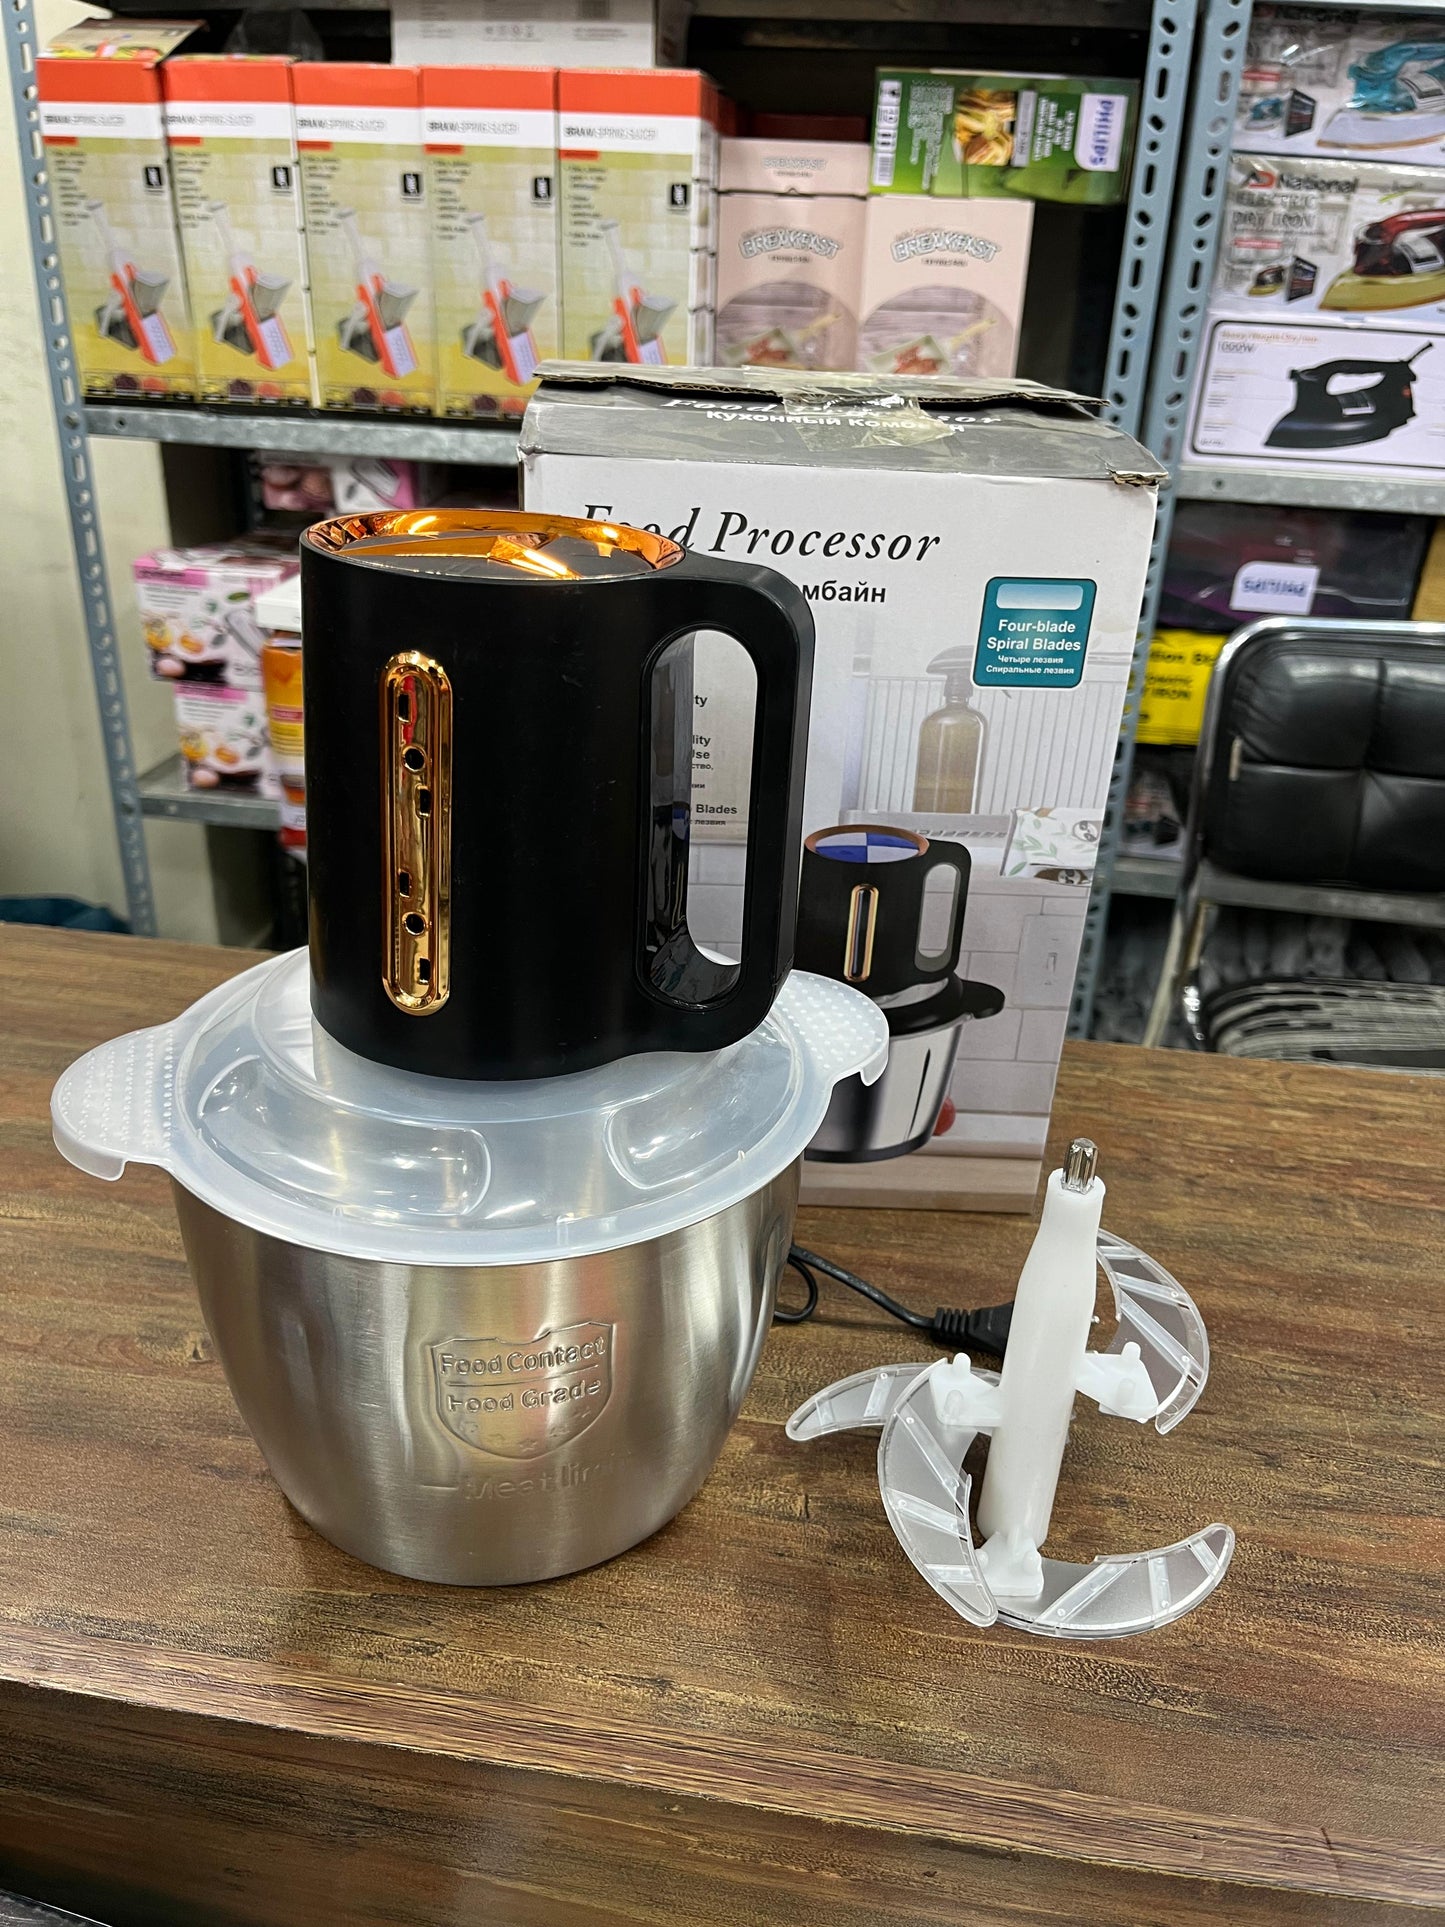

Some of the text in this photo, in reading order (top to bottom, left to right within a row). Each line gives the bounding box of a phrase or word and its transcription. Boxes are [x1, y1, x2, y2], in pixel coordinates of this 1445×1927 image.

[1089, 100, 1115, 167] PHILIPS
[1281, 175, 1358, 193] National
[891, 229, 1002, 262] BREAKFAST
[660, 399, 778, 413] Food
[706, 411, 841, 426] Кухонный
[849, 419, 965, 433] Комбн
[584, 504, 941, 562] Fd Processor
[802, 580, 886, 603] мбайн
[998, 619, 1076, 633] Four-blade
[986, 636, 1081, 652] Spiral Blades
[997, 654, 1031, 665] Четыре
[986, 664, 1042, 674] Спиральные
[694, 694, 708, 708] ty
[692, 734, 711, 748] lity
[696, 803, 738, 815] Blades
[440, 1335, 606, 1375] Food Contact
[447, 1378, 602, 1413] Food Grade
